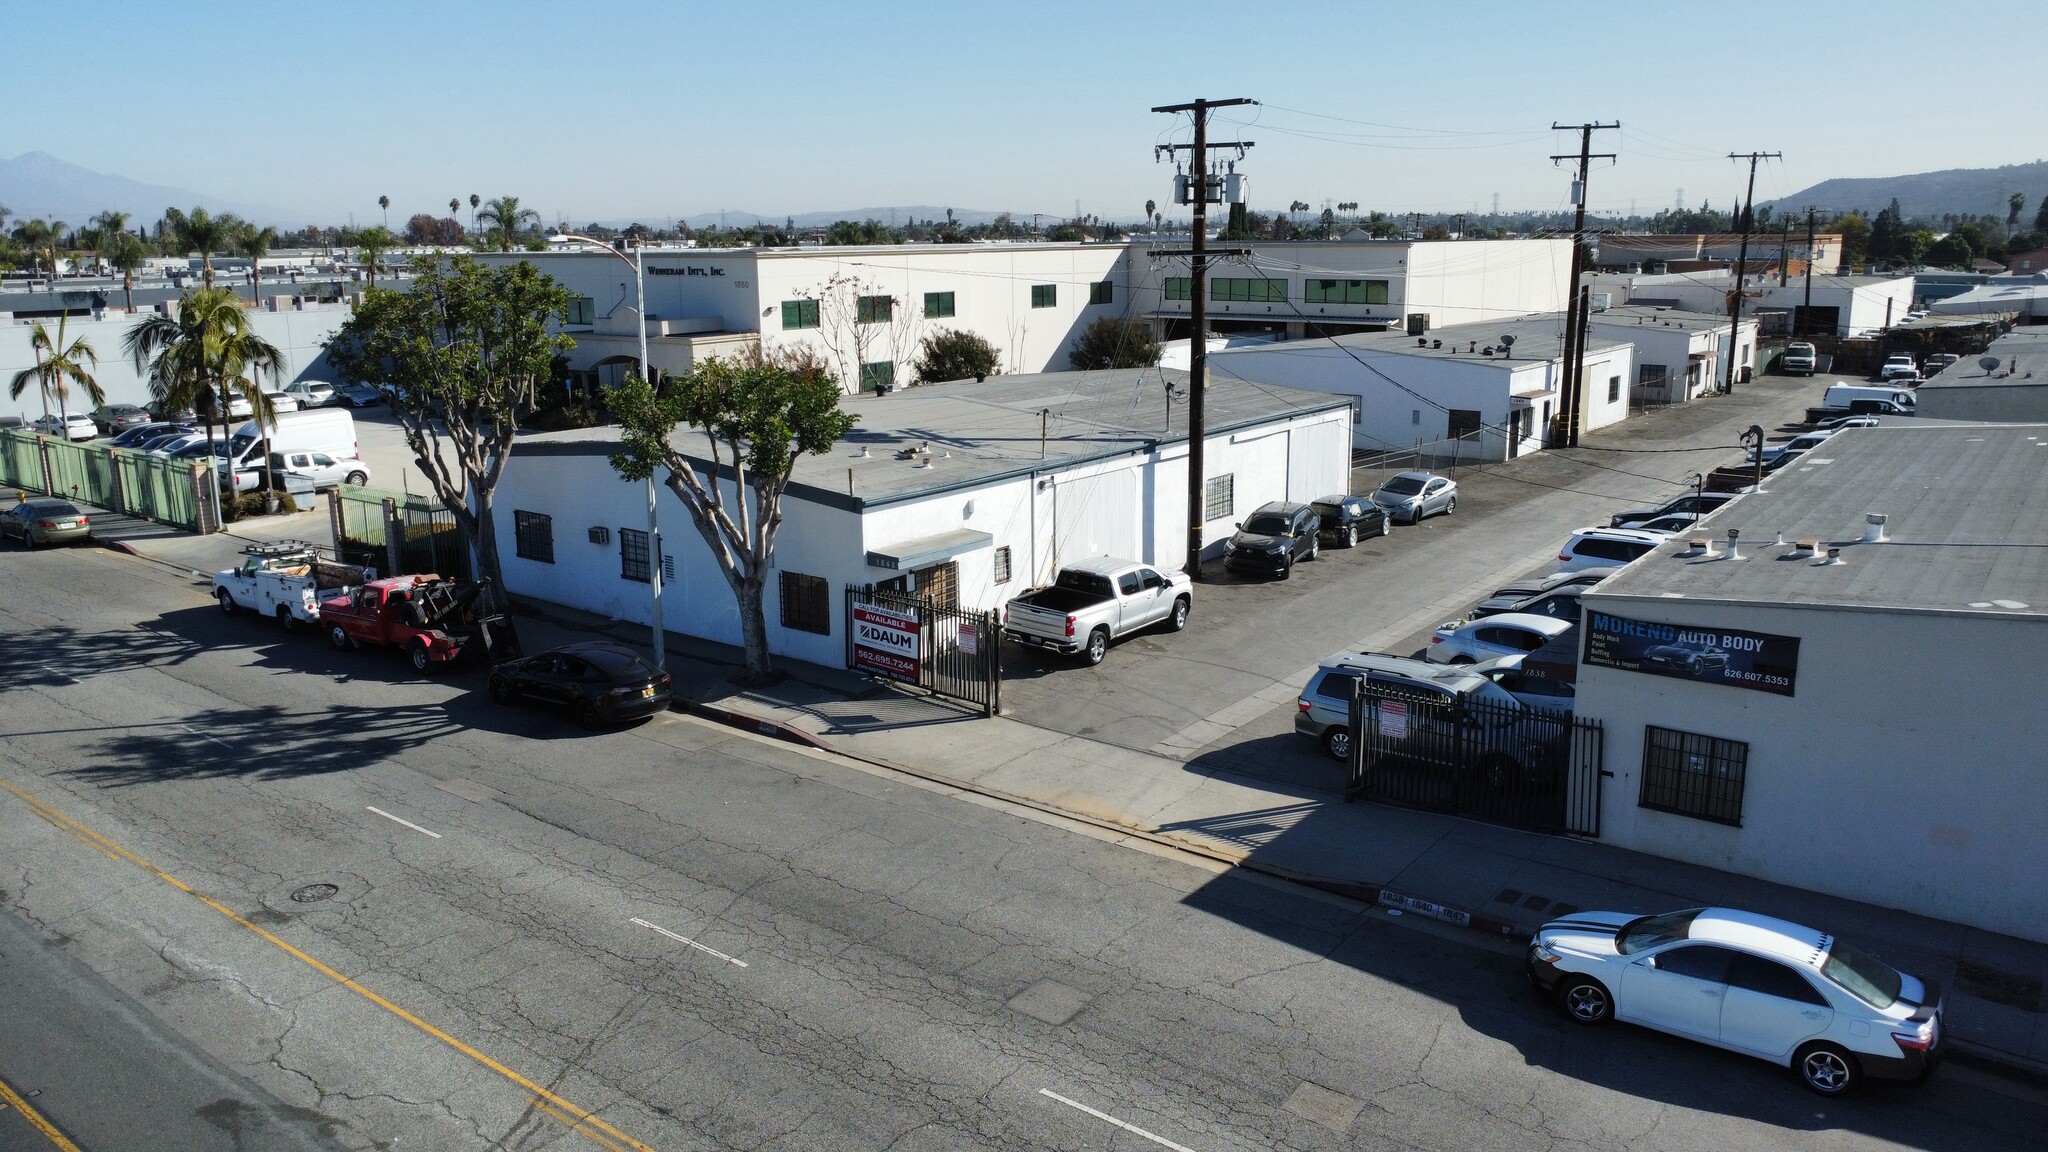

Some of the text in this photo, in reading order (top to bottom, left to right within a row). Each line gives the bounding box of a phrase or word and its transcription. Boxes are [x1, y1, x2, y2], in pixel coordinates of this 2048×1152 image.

[710, 266, 726, 276] INC.
[876, 558, 896, 569] 1848
[858, 603, 869, 611] CALL
[865, 613, 906, 629] AVAILABLE
[871, 628, 912, 649] DAUM
[1592, 632, 1620, 642] Body Work
[1593, 614, 1765, 653] MORENO AUTO BODY
[1591, 640, 1606, 648] Paint
[1591, 647, 1610, 657] Buffing
[857, 649, 915, 671] 562.695.7244
[1589, 656, 1615, 665] Domestic
[1621, 660, 1640, 669] Import
[1525, 668, 1546, 678] 1838
[1724, 668, 1789, 686] 626.607.5353
[1411, 899, 1433, 913] 1840
[1443, 908, 1465, 922] 1842
